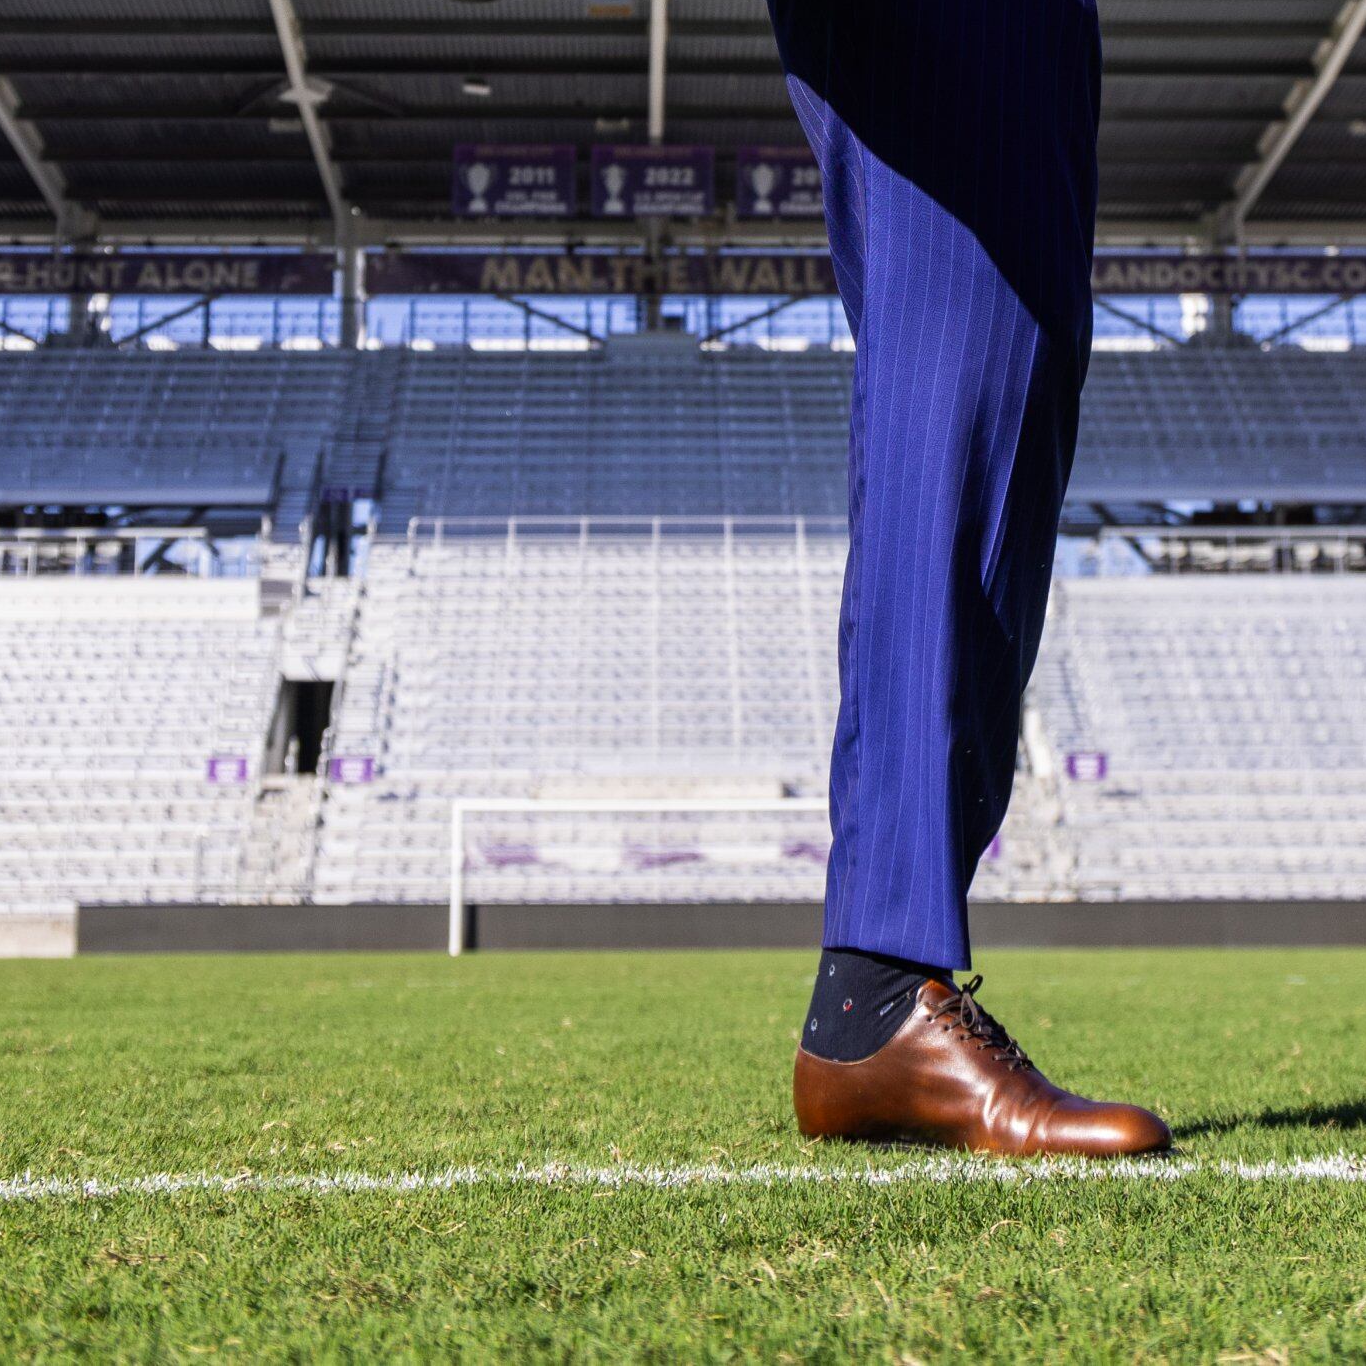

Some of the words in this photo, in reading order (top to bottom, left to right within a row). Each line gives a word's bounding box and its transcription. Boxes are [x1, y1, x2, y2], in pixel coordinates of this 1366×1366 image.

[509, 166, 555, 185] 2011
[645, 166, 695, 186] 2022
[792, 166, 822, 186] 20
[26, 260, 125, 289] HUNT
[137, 260, 259, 289] ALONE
[480, 256, 593, 291] MAN
[608, 256, 688, 291] THE
[709, 256, 827, 291] WALL
